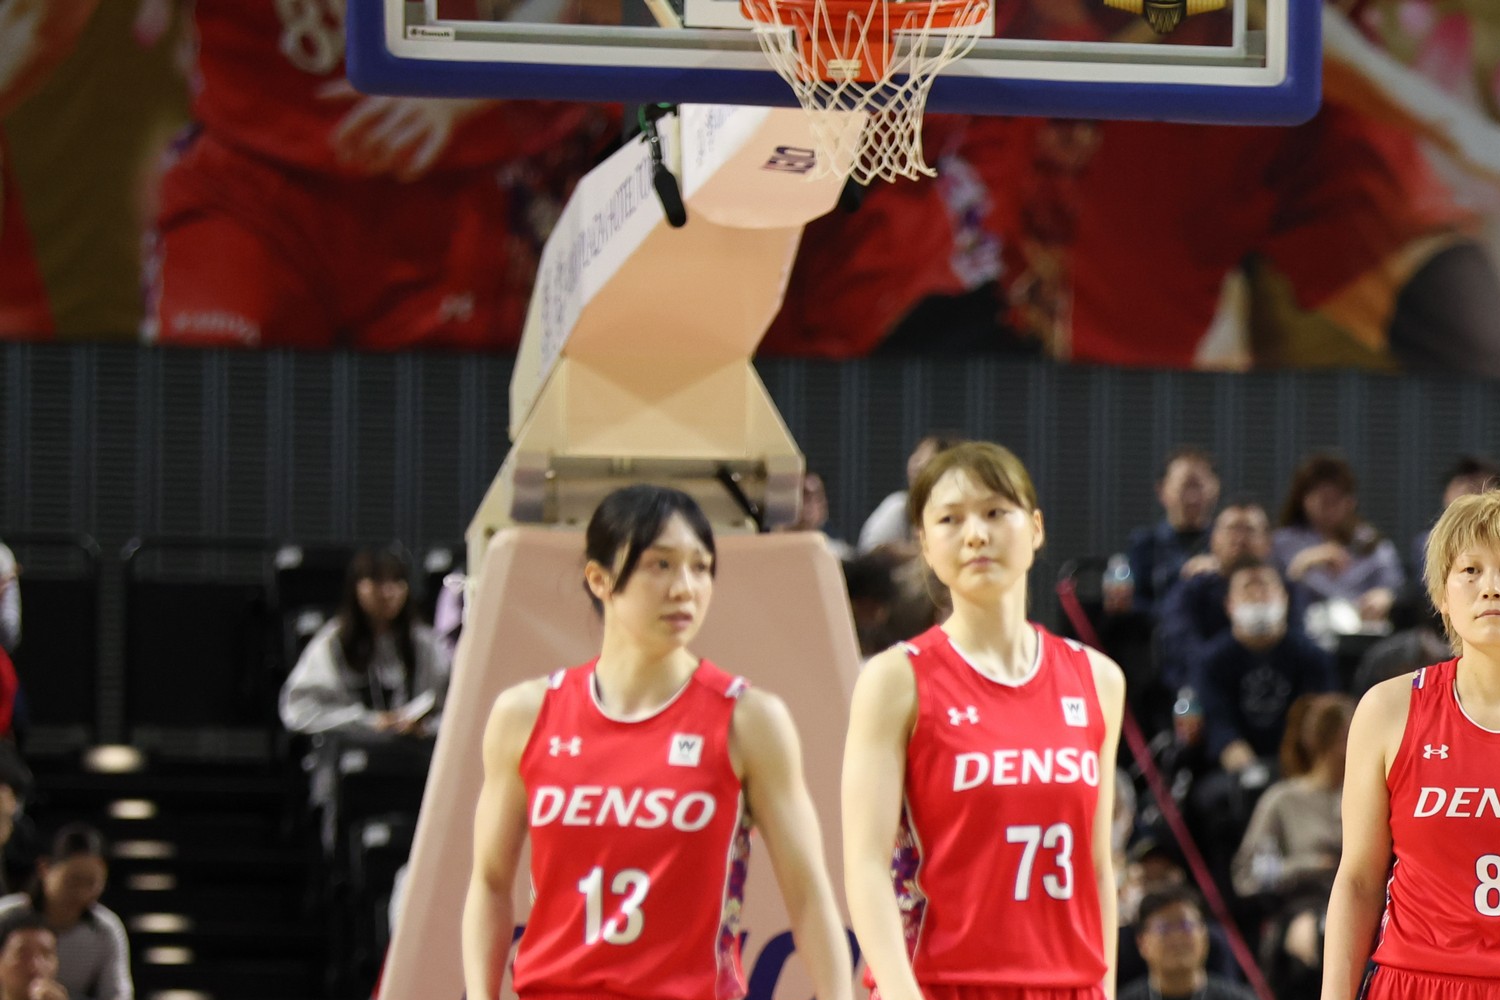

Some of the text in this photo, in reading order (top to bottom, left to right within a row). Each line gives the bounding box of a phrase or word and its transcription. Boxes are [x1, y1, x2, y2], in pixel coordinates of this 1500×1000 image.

[678, 741, 696, 751] W
[954, 748, 1097, 791] DENSO
[531, 786, 715, 832] DENSO
[1006, 823, 1074, 901] 73
[578, 866, 650, 945] 13
